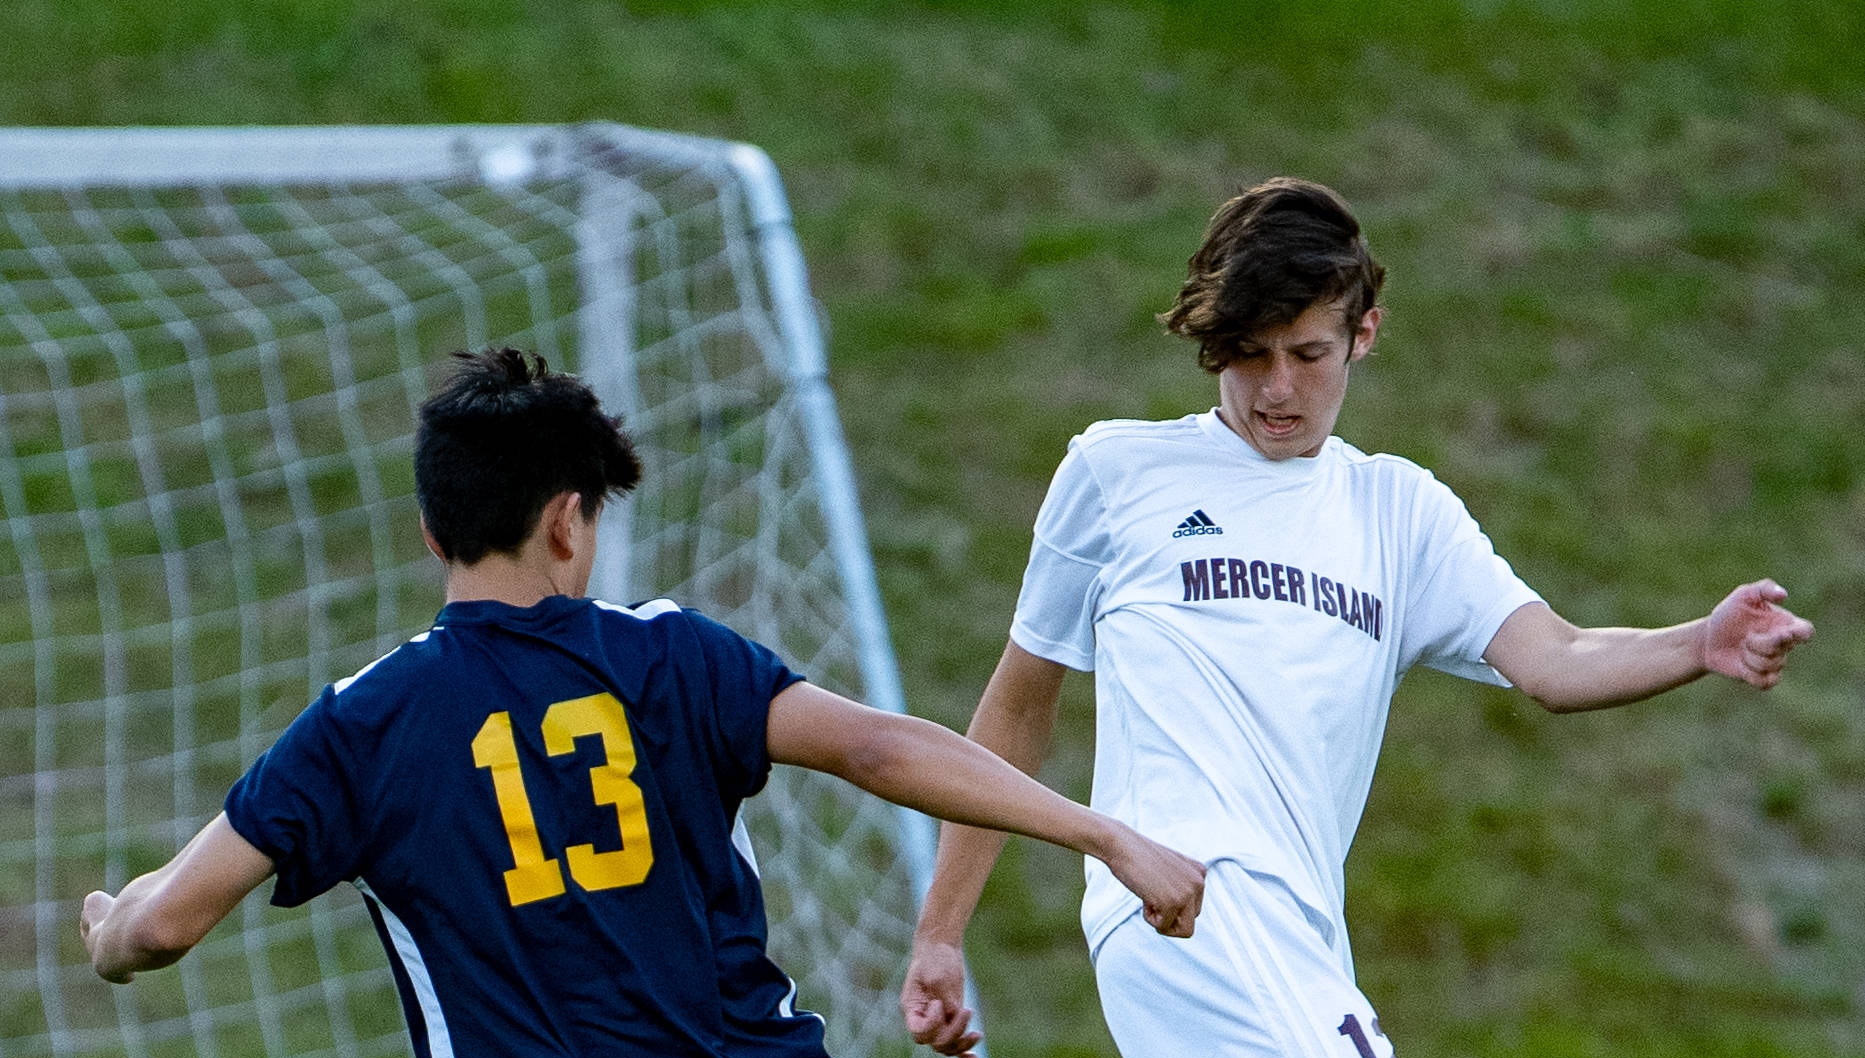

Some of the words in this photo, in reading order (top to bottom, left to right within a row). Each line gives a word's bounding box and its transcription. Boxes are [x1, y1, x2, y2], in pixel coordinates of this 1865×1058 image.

[1172, 524, 1224, 538] adidas
[1181, 557, 1306, 606] MERCER
[1311, 572, 1383, 642] ISLAND
[471, 692, 654, 907] 13
